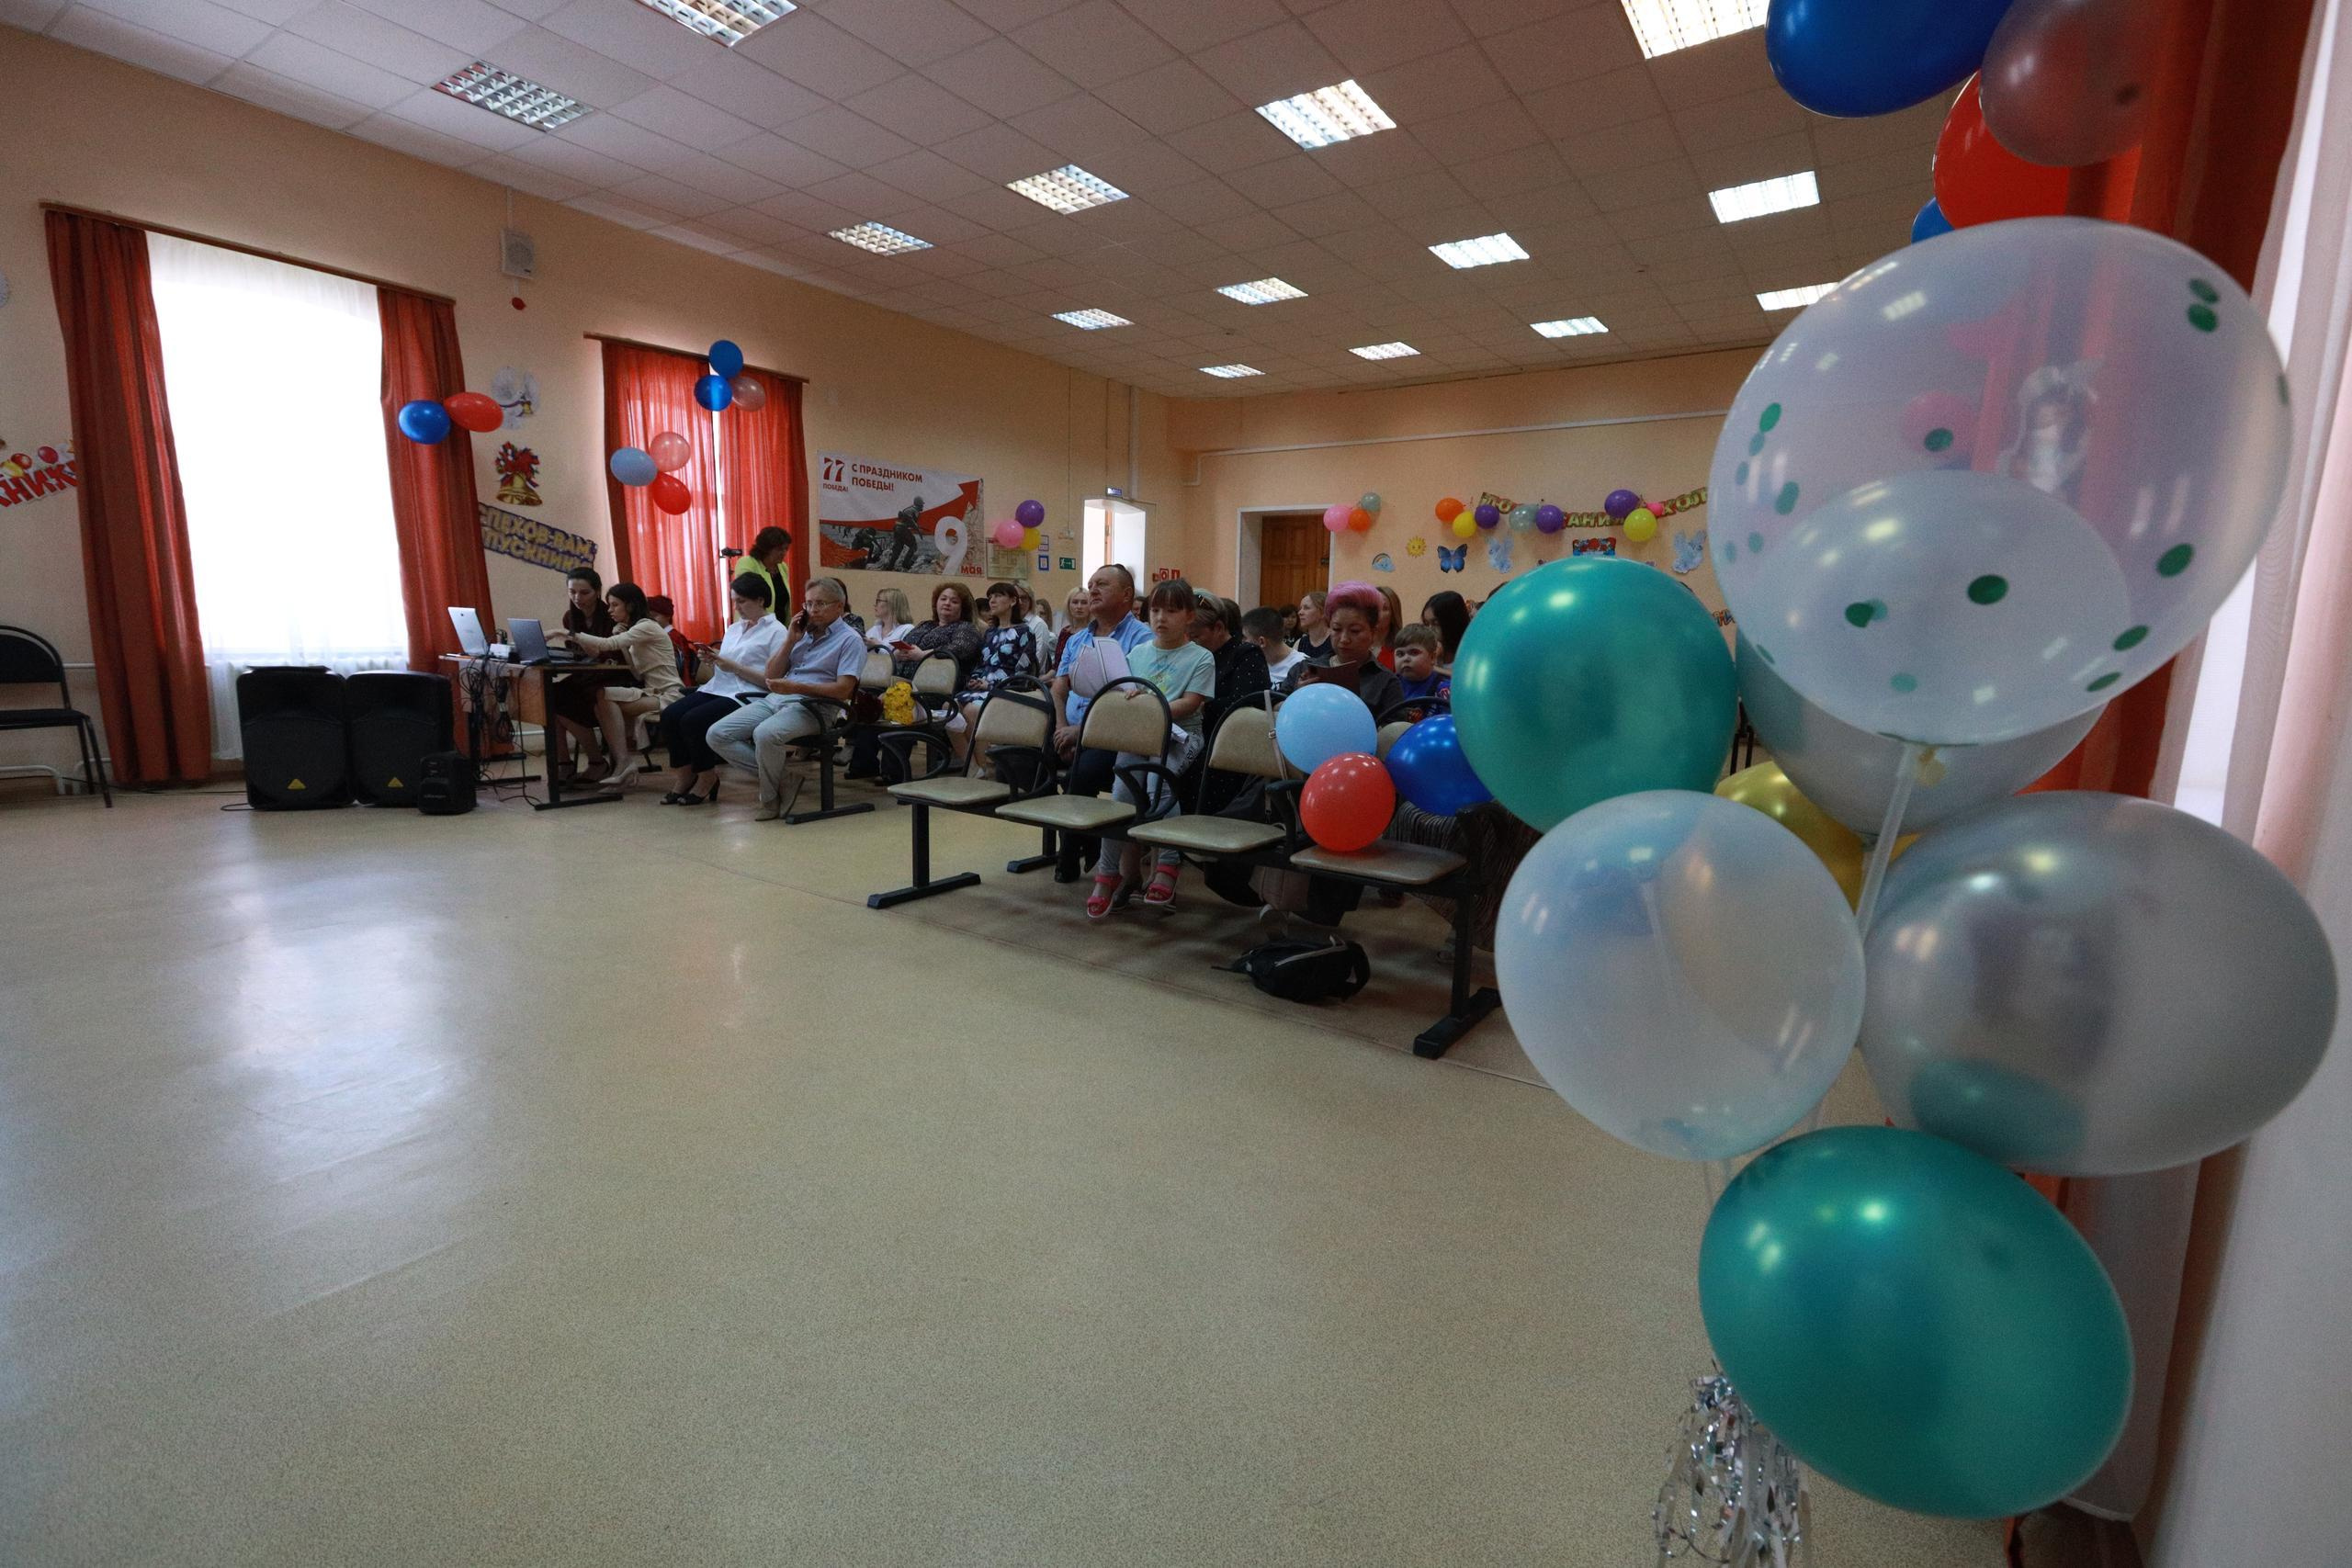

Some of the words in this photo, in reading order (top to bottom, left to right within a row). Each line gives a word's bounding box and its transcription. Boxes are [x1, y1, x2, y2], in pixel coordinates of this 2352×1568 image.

[823, 457, 845, 482] 77
[851, 463, 858, 473] С
[859, 465, 923, 483] ПРАЗДНИКОМ
[852, 477, 894, 491] ПОБЕДЫ!
[480, 506, 550, 545] СПЕХОВ
[934, 515, 967, 576] 9
